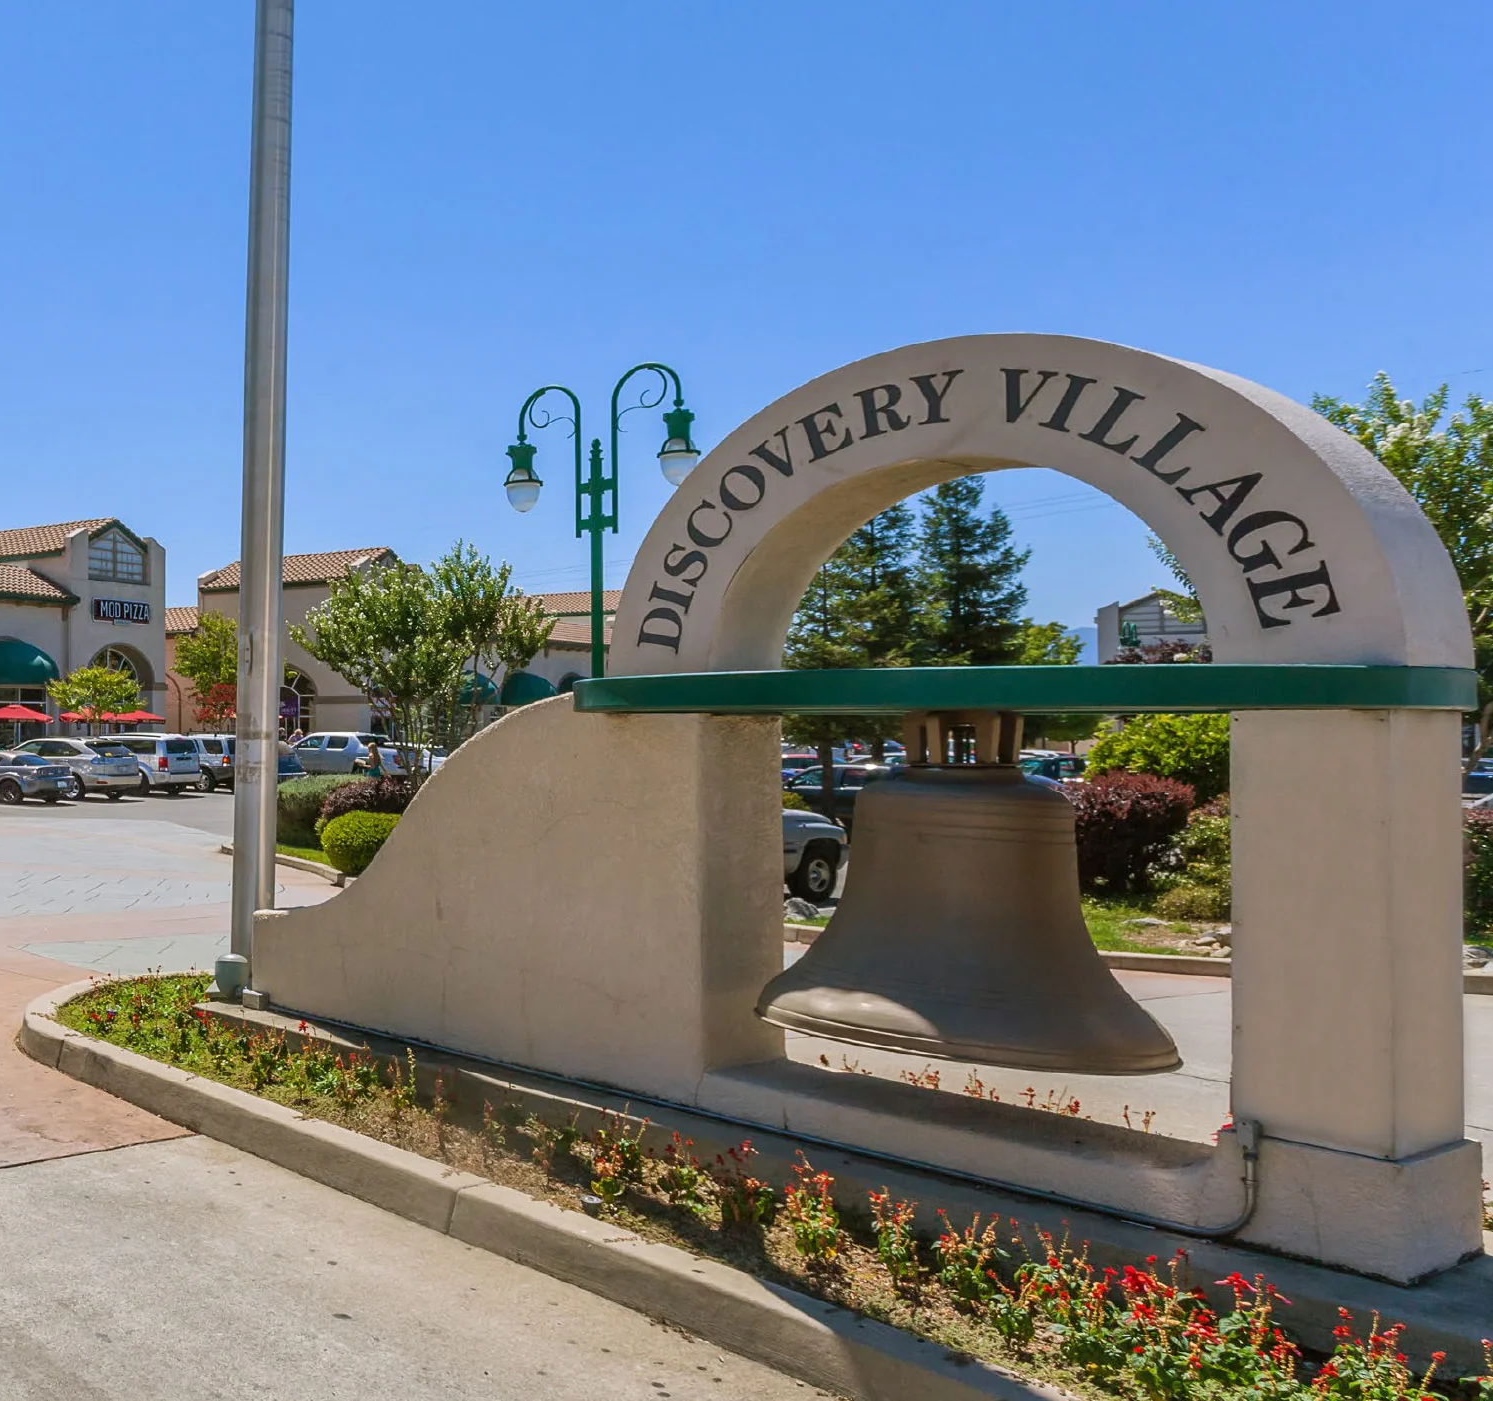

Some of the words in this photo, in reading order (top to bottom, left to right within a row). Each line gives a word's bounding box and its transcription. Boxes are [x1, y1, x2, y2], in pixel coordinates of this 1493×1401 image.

[636, 368, 964, 655] DISCOVERY
[1000, 367, 1341, 629] VILLAGE
[100, 600, 121, 618] MOD
[123, 603, 150, 620] PIZZA
